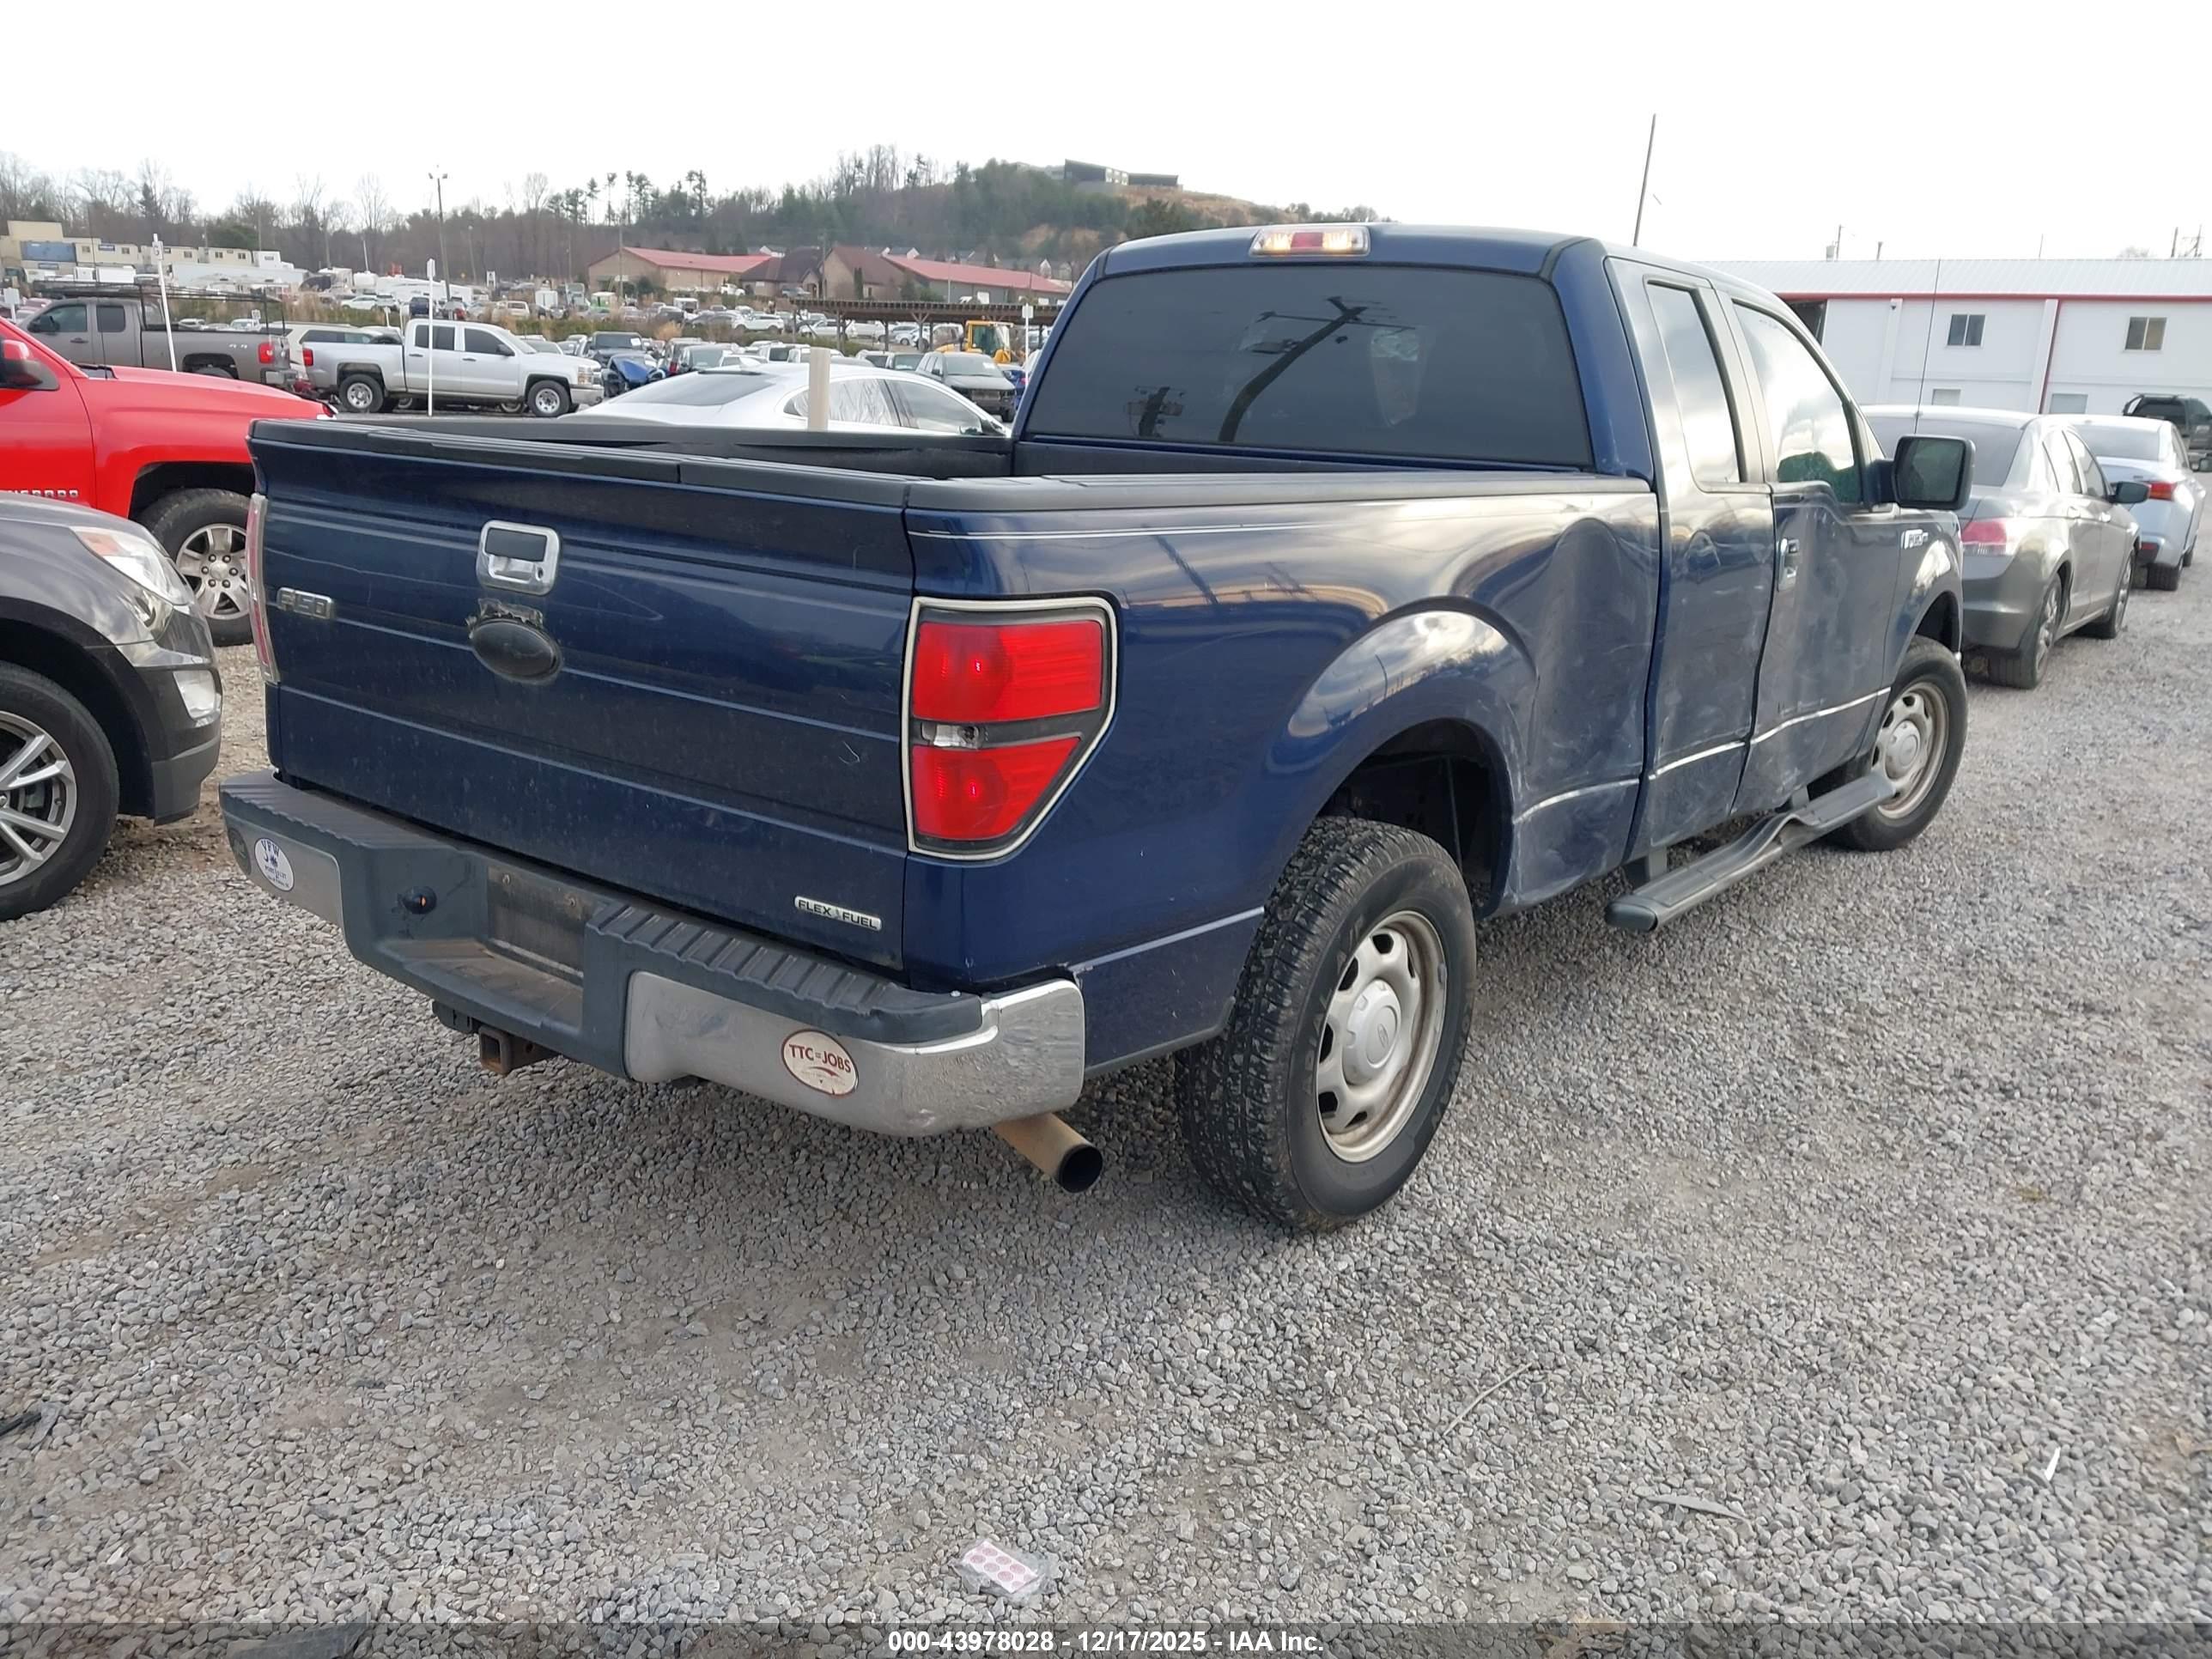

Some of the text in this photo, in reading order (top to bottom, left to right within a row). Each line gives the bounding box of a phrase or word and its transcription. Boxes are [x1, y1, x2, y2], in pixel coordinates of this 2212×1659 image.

[798, 899, 877, 929] FLEX FUEL
[788, 1043, 814, 1061] TTC
[822, 1050, 852, 1073] JOBS
